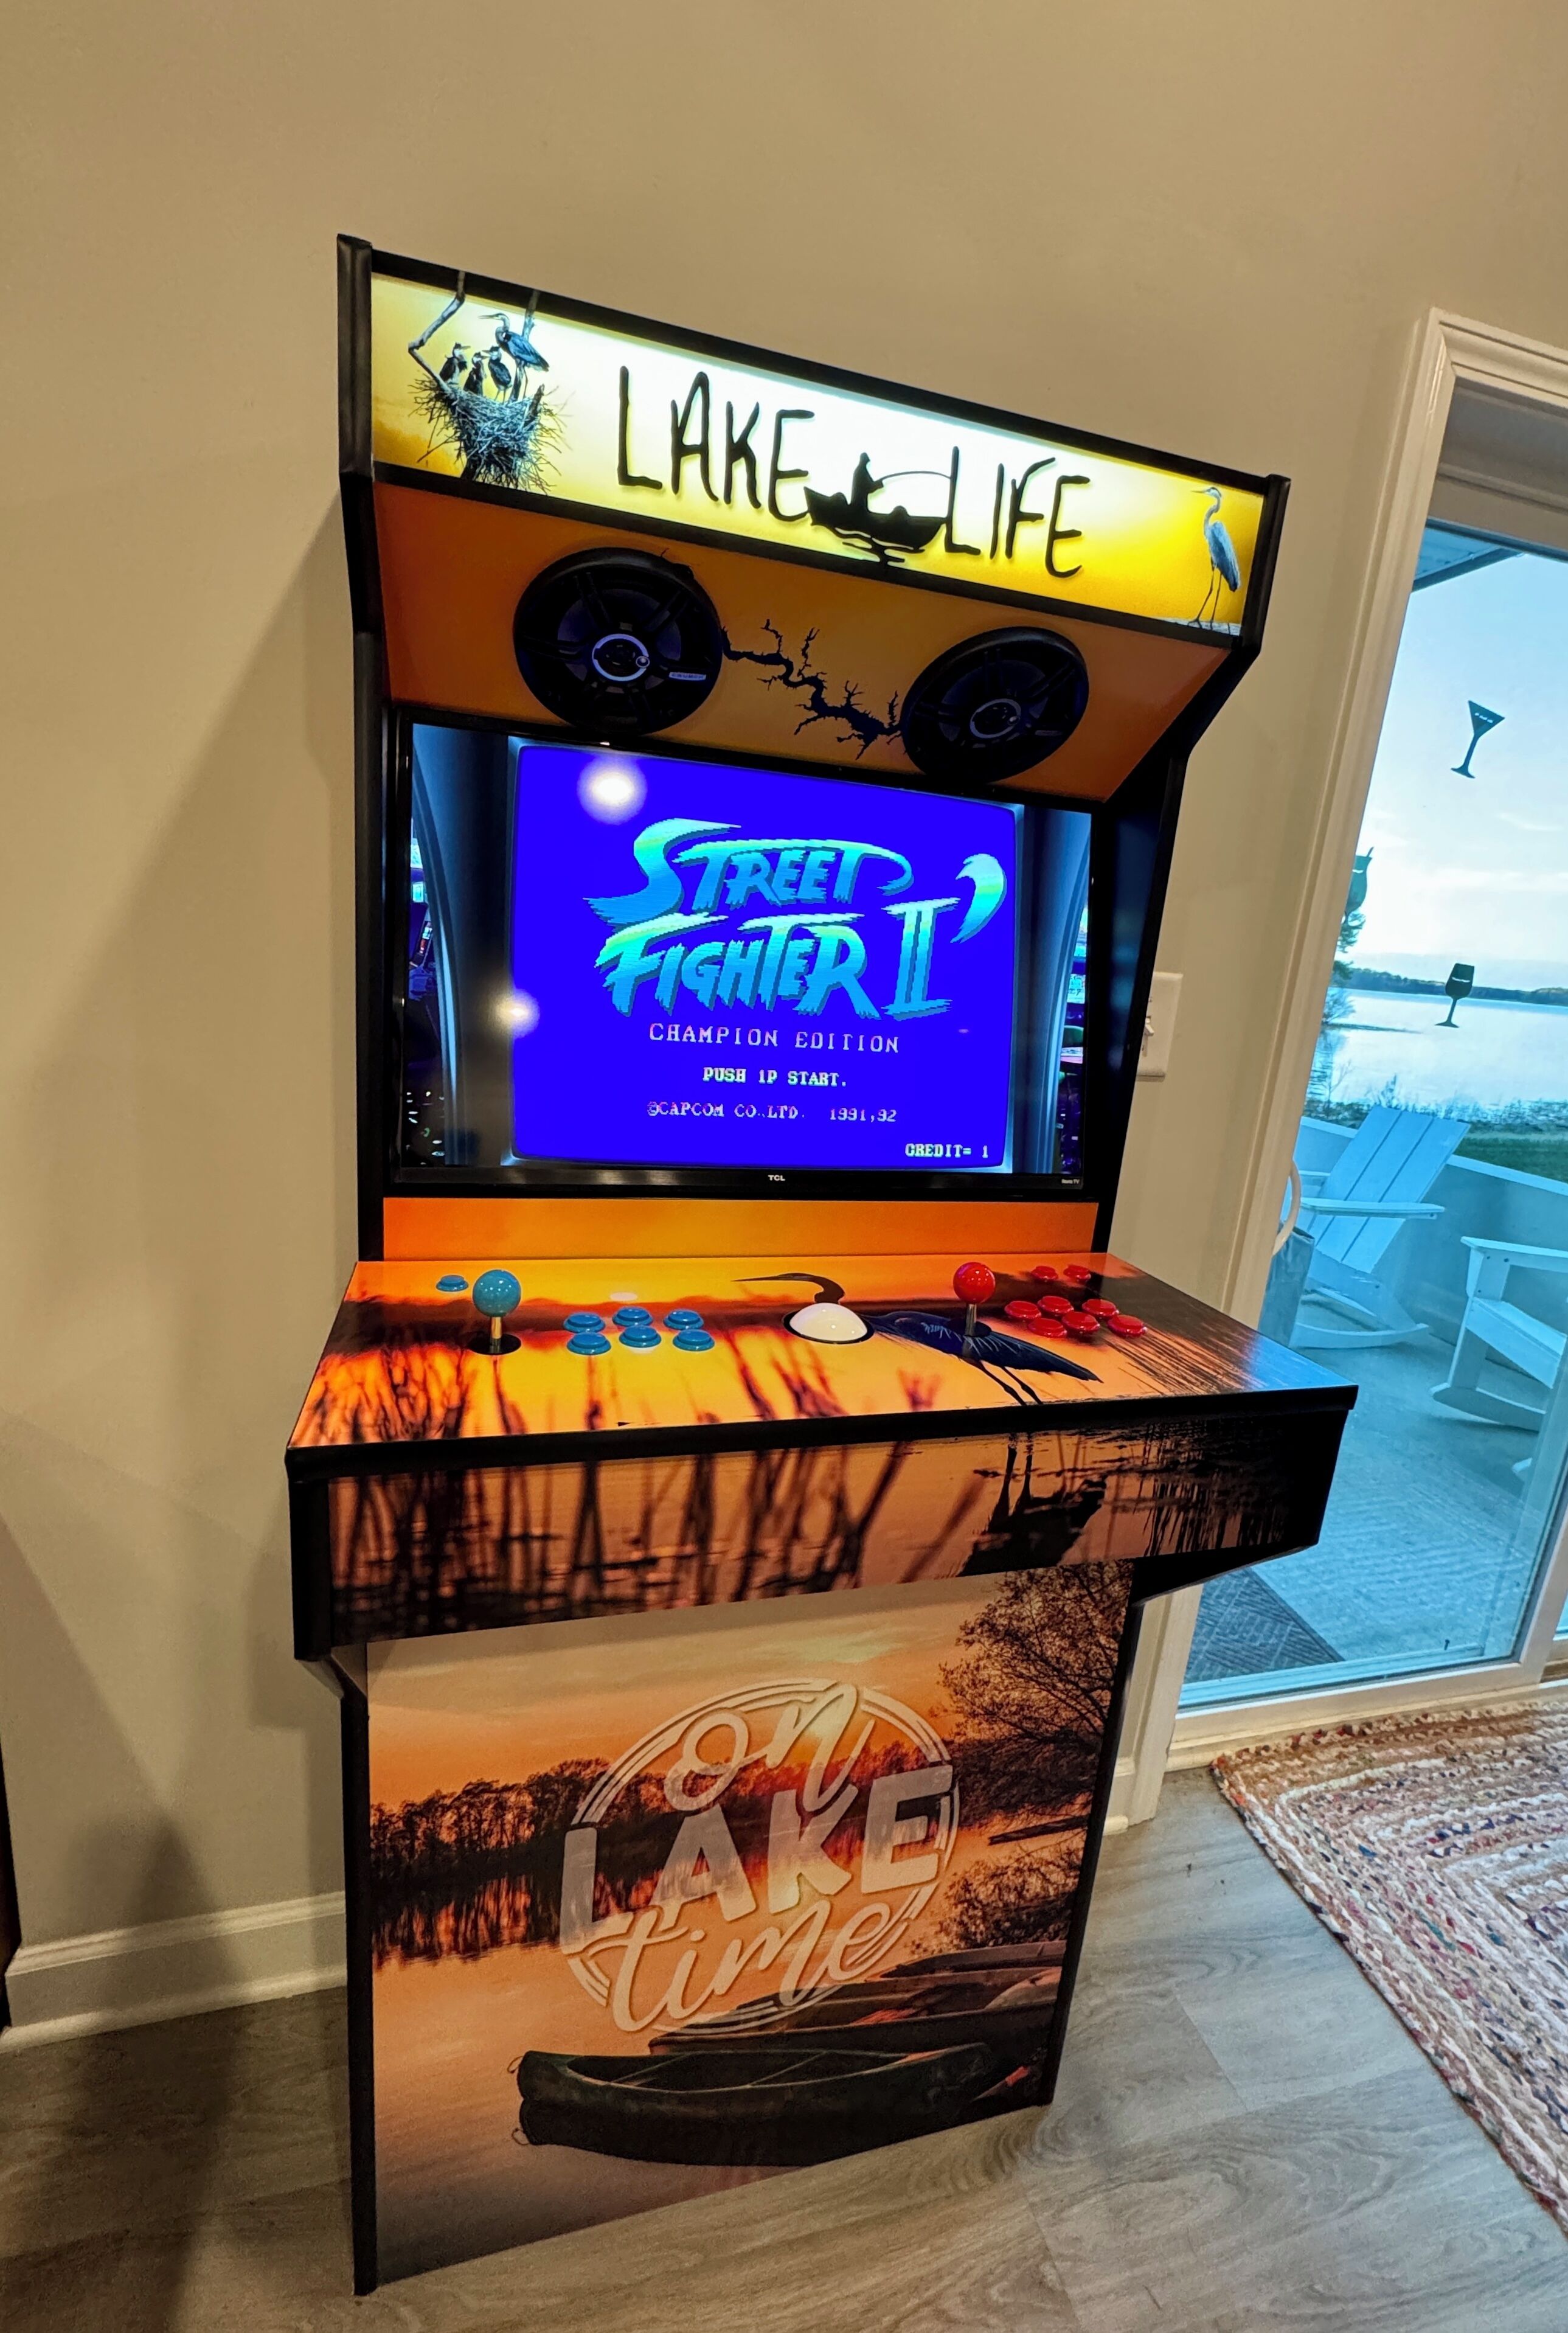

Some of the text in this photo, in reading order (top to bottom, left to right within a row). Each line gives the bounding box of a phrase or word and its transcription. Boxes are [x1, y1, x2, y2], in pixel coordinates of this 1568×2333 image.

[617, 366, 1091, 579] LAKE LIFE
[583, 817, 914, 930] STREET
[594, 911, 882, 1018] FIGHTER
[649, 1023, 899, 1053] CHAMPION EDITION
[702, 1066, 847, 1087] PUSH 1P START.
[830, 1108, 898, 1123] 1991,92
[664, 1683, 876, 1811] on
[560, 1765, 953, 1955] LAKE
[588, 1899, 909, 2032] time
